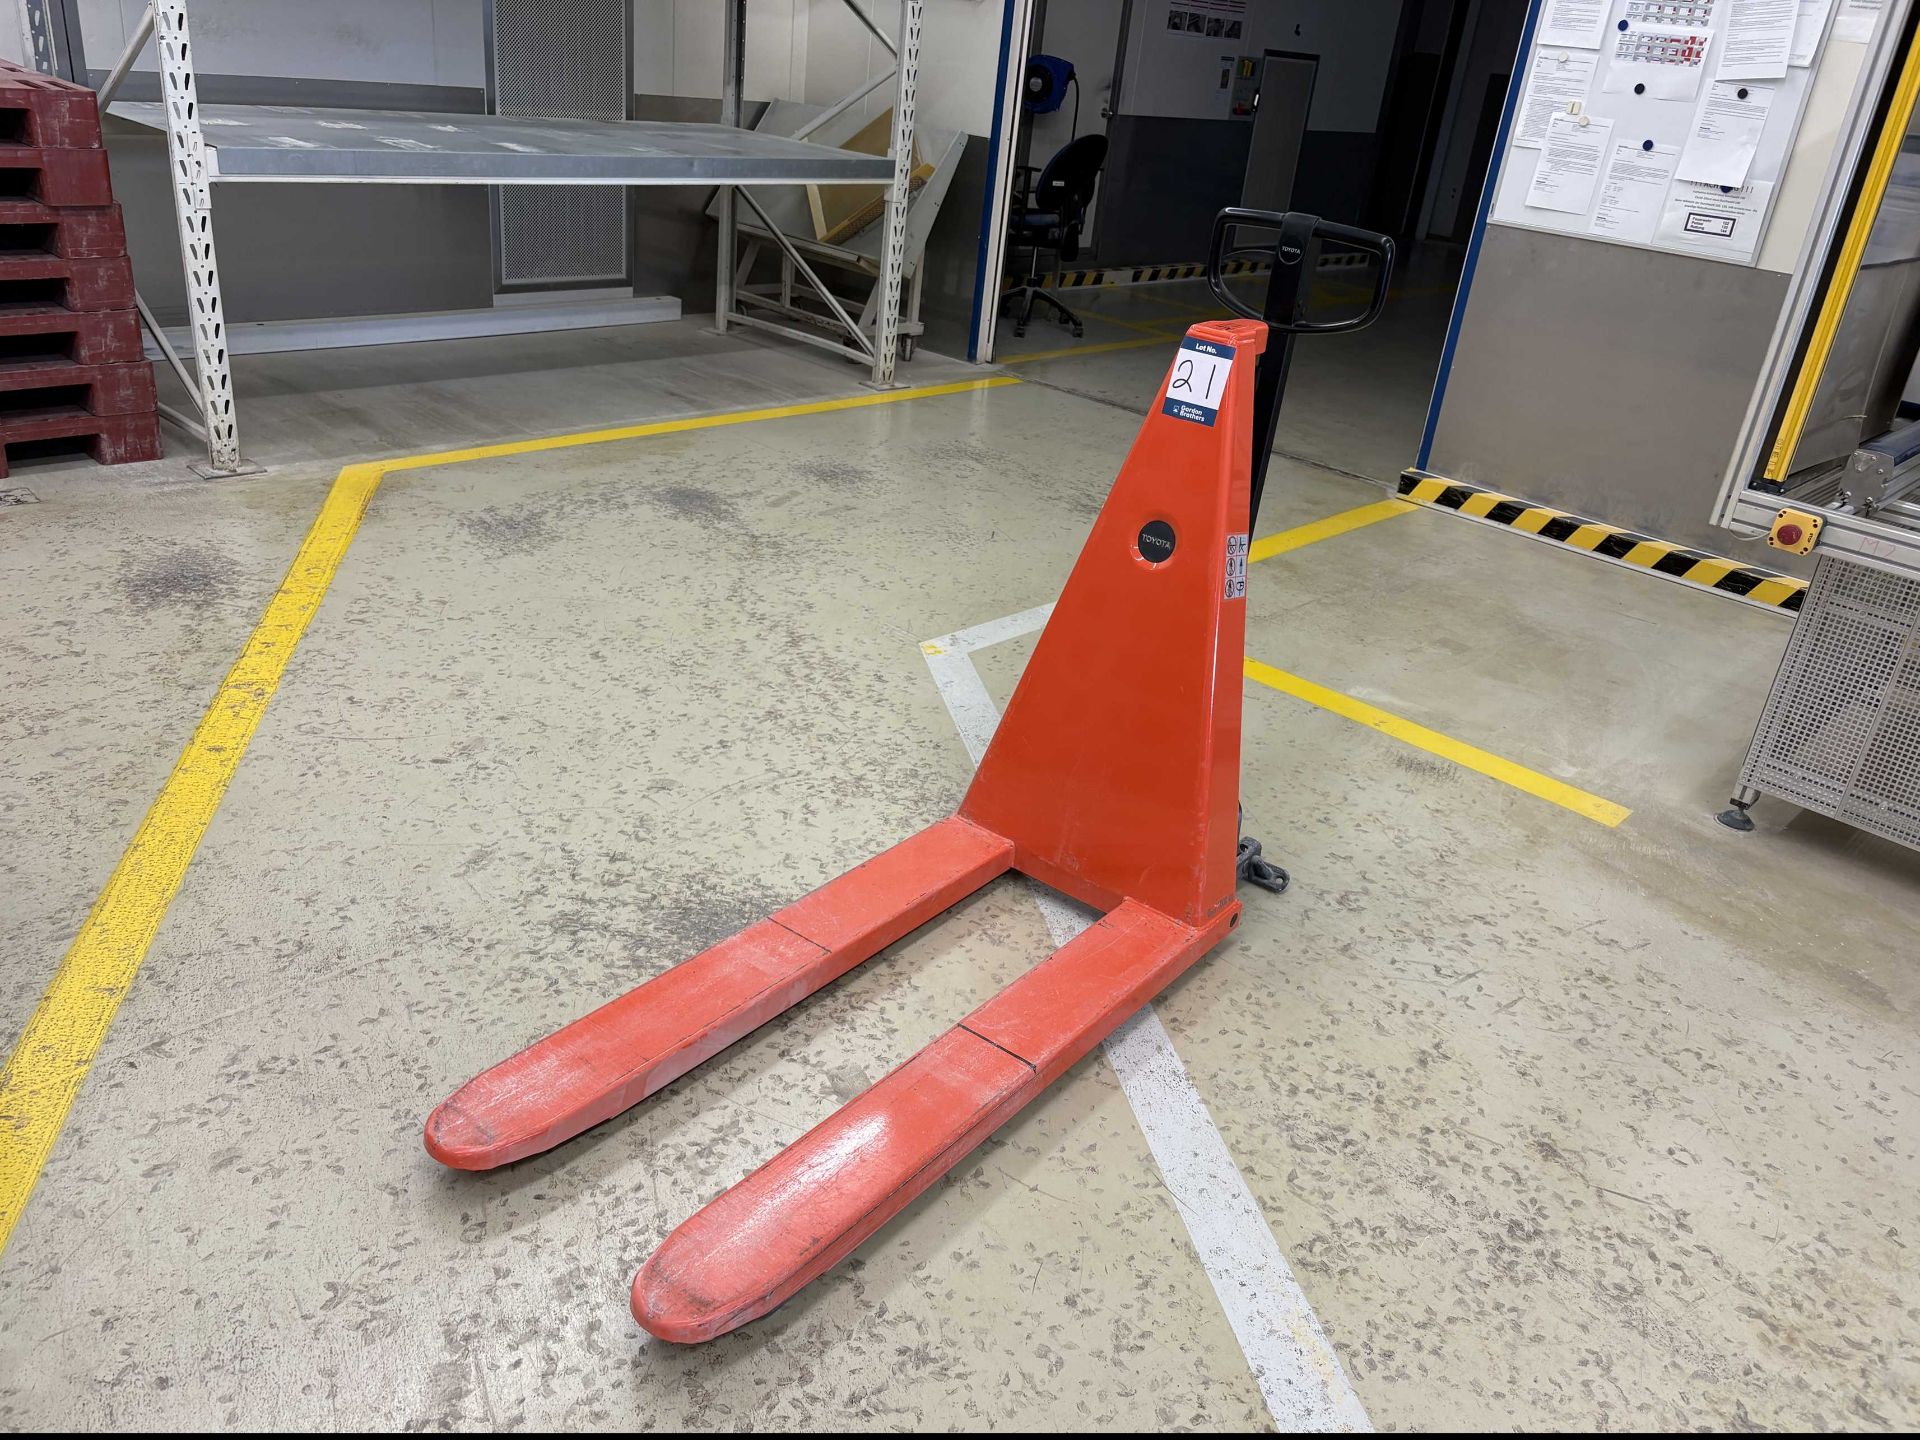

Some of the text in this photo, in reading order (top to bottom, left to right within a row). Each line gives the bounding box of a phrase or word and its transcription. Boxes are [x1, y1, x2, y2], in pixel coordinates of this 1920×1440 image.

[1282, 245, 1300, 254] TOYOTA
[1196, 343, 1217, 354] Lot No.
[1172, 359, 1216, 400] 21
[1180, 404, 1202, 415] Gordon
[1180, 411, 1204, 422] Brothers
[1142, 533, 1171, 550] TOYOTA
